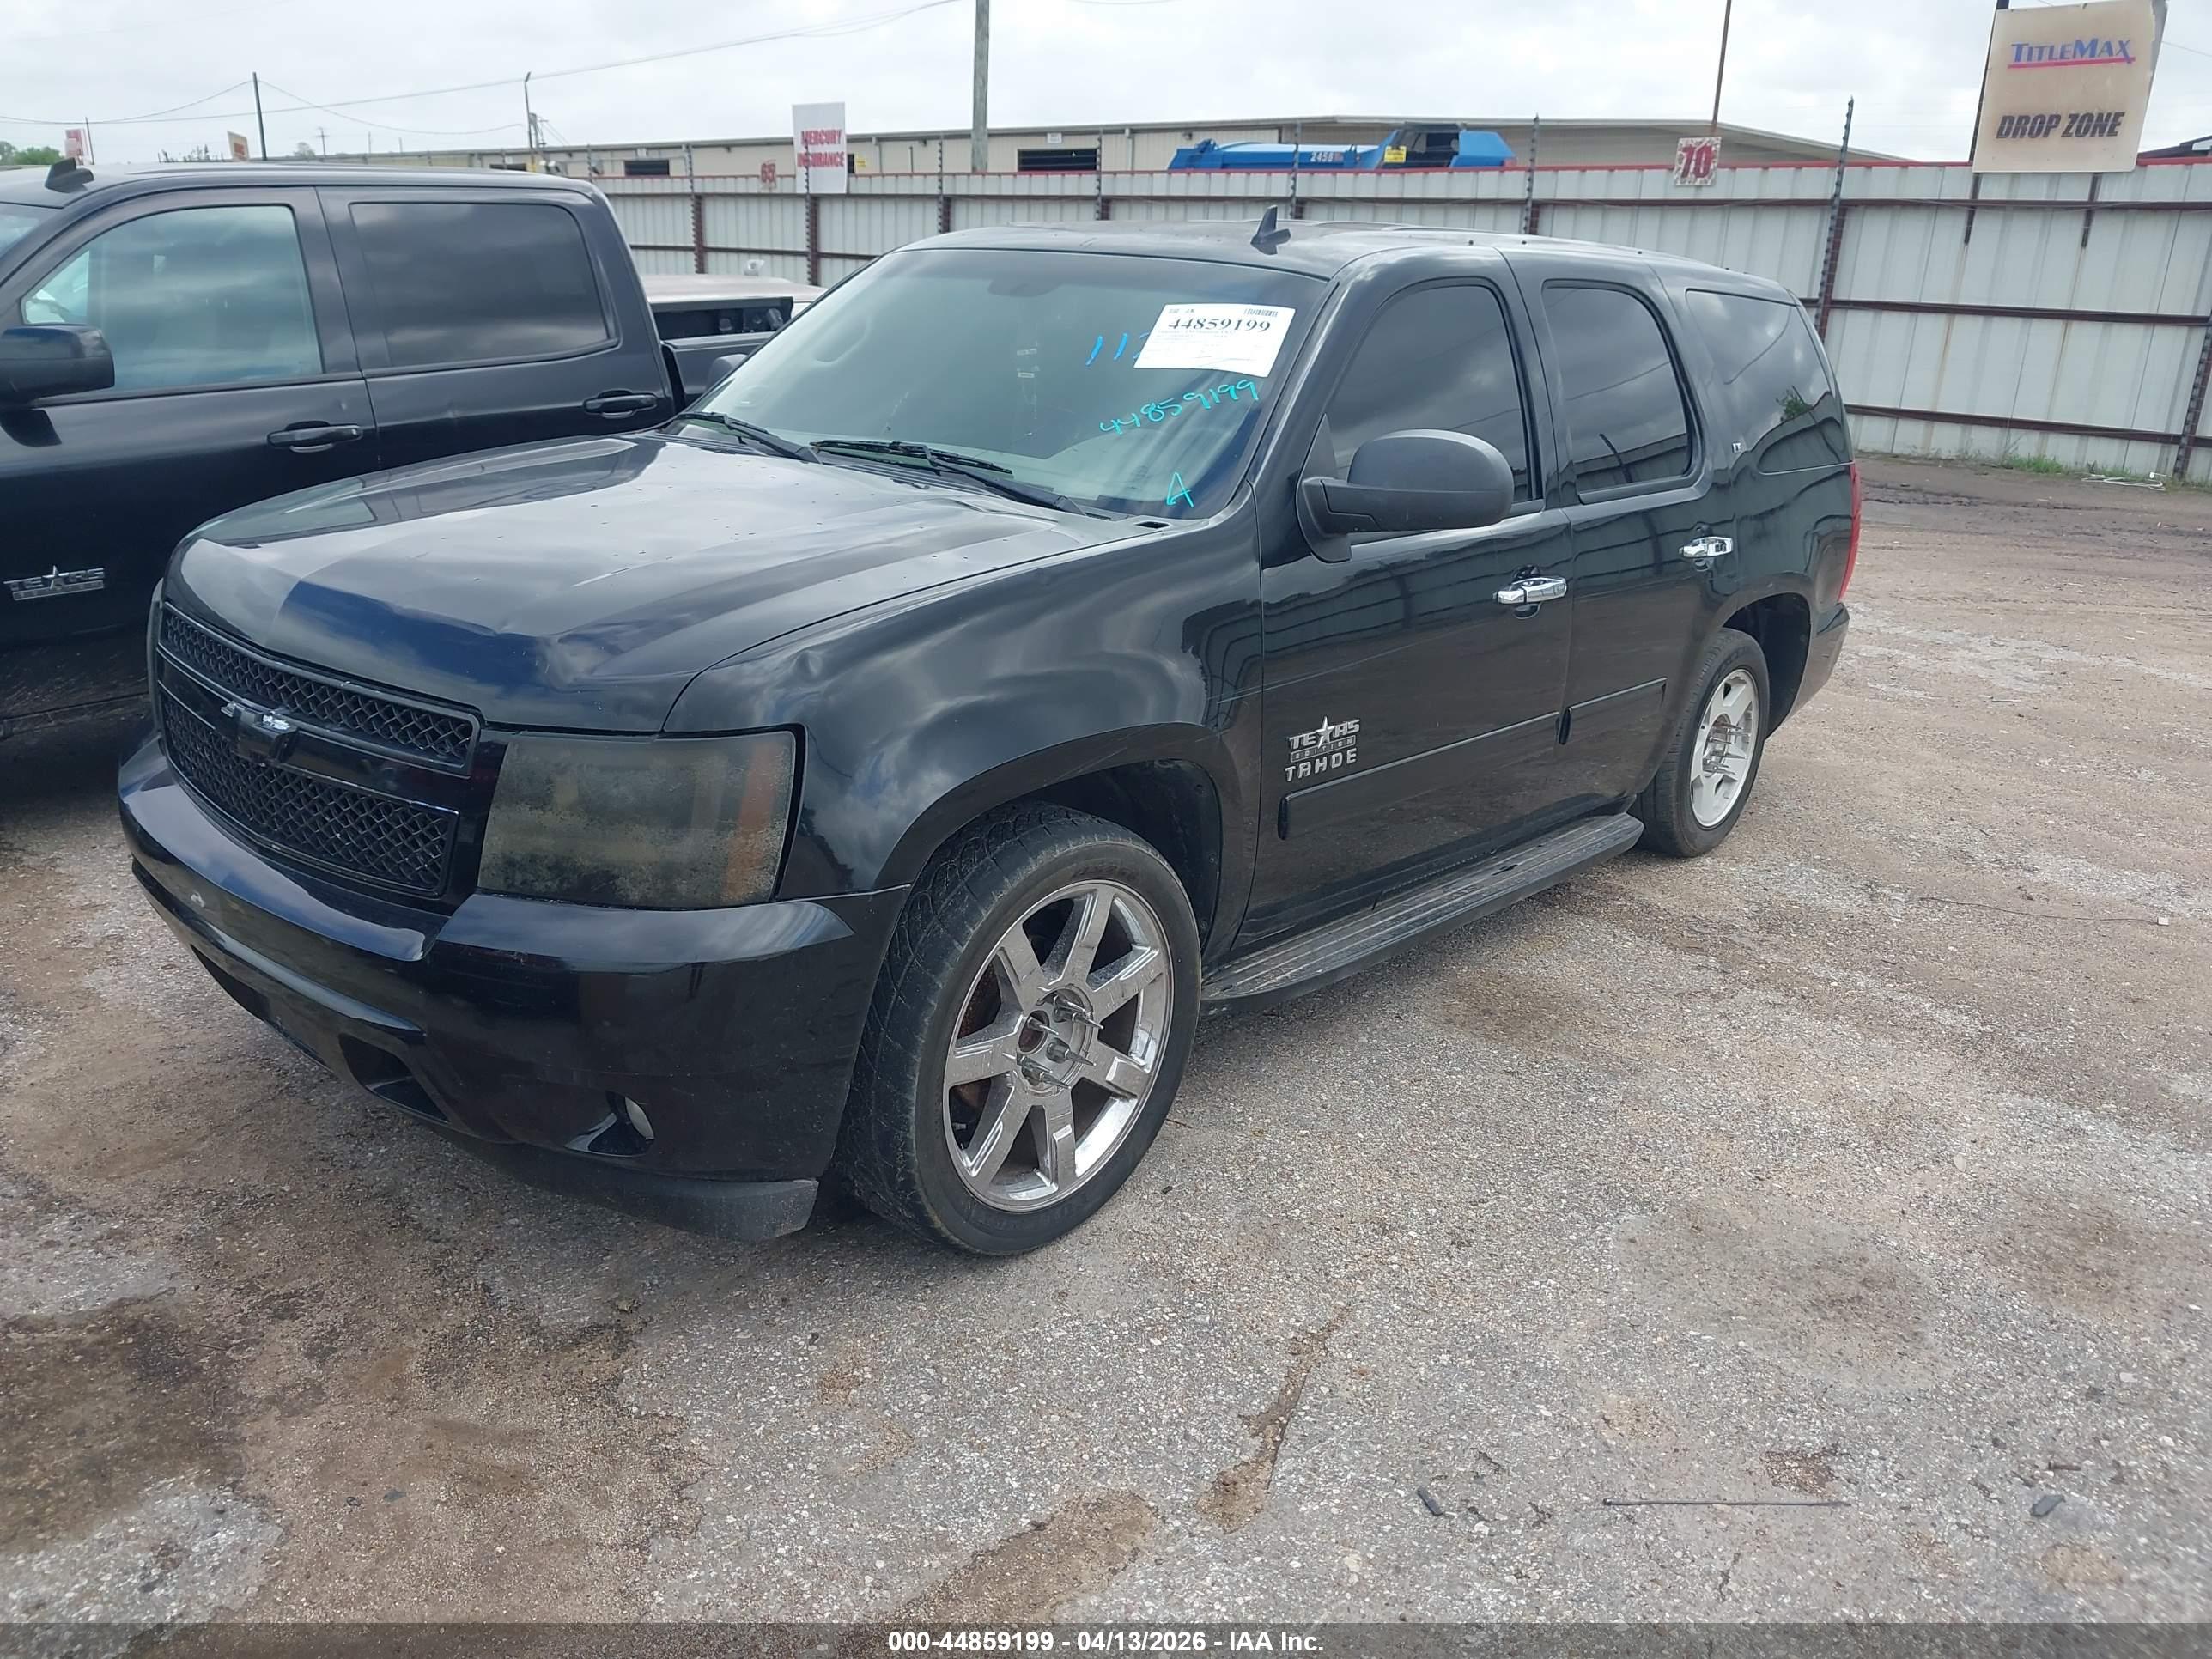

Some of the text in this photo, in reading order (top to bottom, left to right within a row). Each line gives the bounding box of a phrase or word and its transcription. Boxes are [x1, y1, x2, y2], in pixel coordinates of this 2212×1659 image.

[800, 129, 843, 145] MERCURY
[1996, 111, 2125, 139] DROP ZONE
[796, 150, 845, 167] INSURANCE
[1680, 144, 1712, 179] 70
[1168, 317, 1271, 333] 44859199
[1099, 379, 1259, 434] 44859199
[1166, 472, 1194, 508] A
[1289, 716, 1360, 750] TEXAS
[1285, 748, 1357, 781] TAHOE
